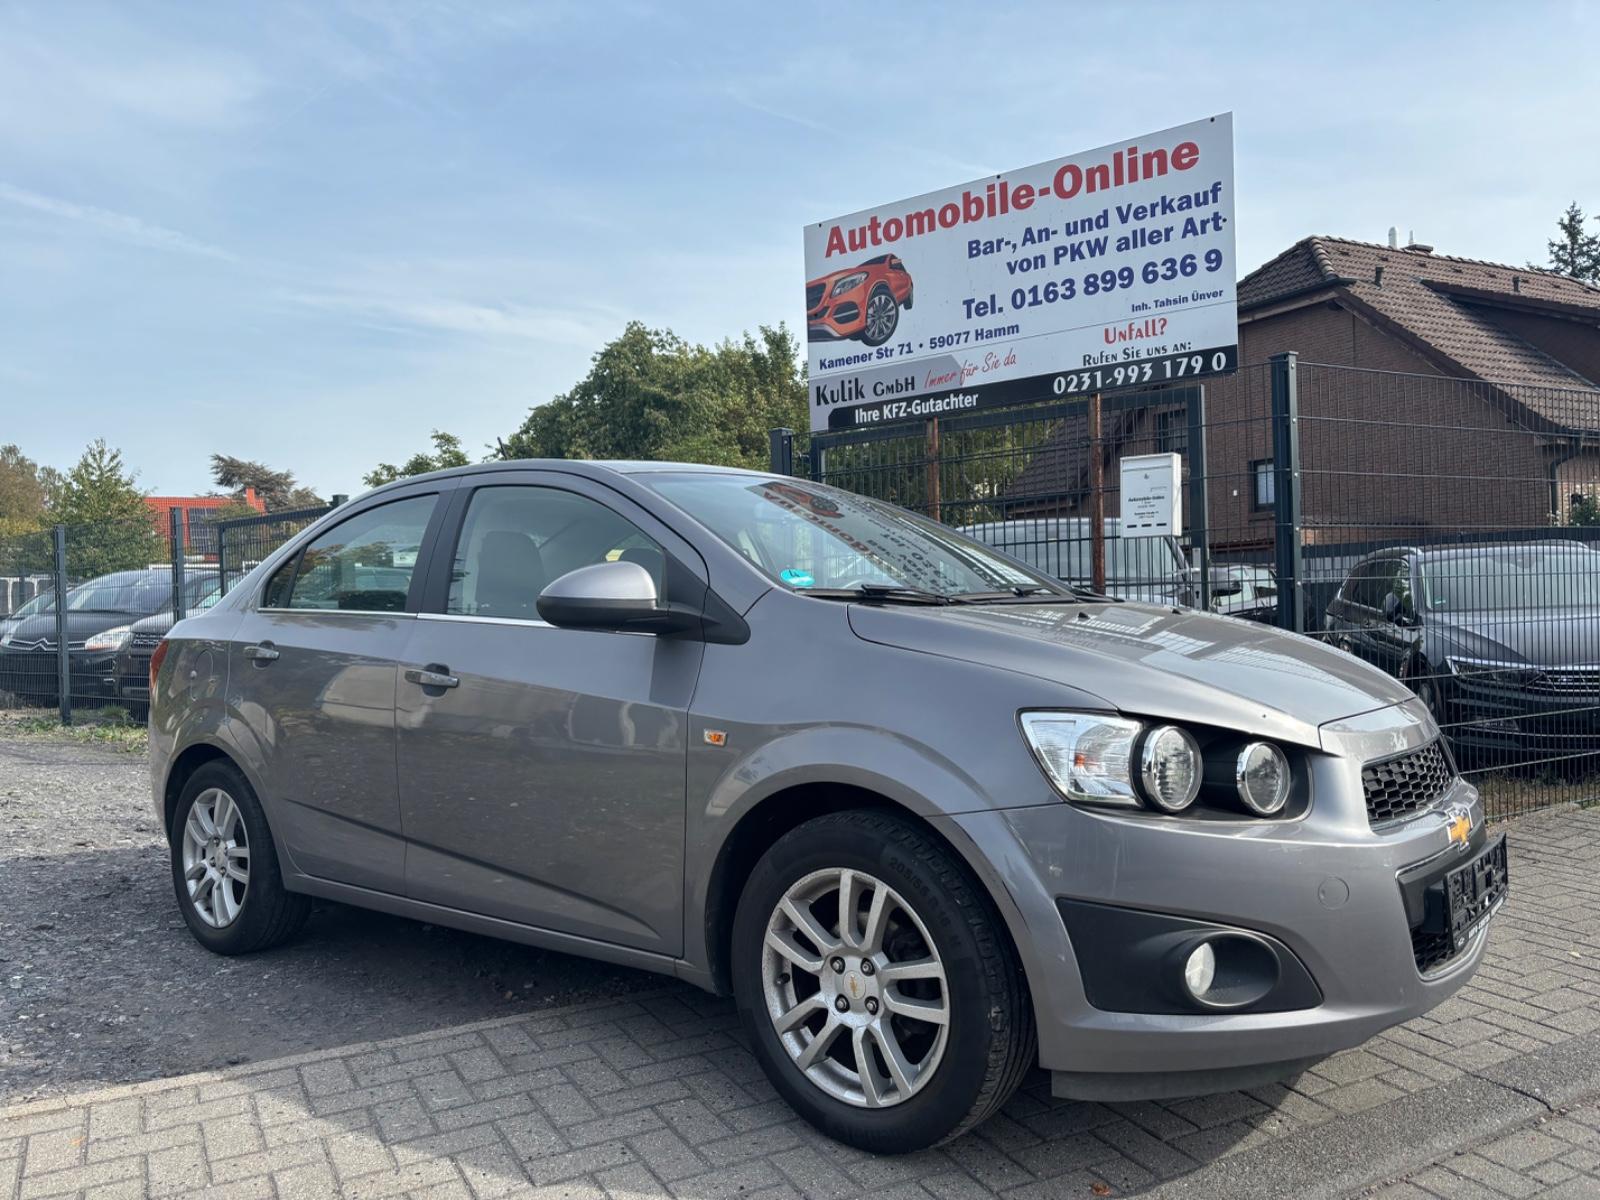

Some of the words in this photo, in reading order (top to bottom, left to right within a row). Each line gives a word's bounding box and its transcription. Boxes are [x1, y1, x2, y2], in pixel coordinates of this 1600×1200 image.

[825, 142, 1199, 258] Automobile-Online
[968, 237, 1017, 259] Bar-,
[1022, 227, 1058, 247] An-
[1065, 208, 1109, 237] und
[1115, 181, 1222, 224] Verkauf
[1006, 254, 1046, 275] von
[1054, 235, 1109, 265] PKW
[1116, 226, 1174, 253] aller
[962, 294, 1004, 320] Tel.
[1011, 278, 1077, 310] 0163
[1083, 266, 1135, 296] 899
[1142, 253, 1198, 284] 636
[1204, 248, 1223, 273] 9
[1131, 302, 1152, 313] Inh.
[1153, 295, 1189, 309] Tahsin
[1191, 289, 1224, 302] Ünver
[820, 352, 873, 370] Kamener
[876, 346, 895, 360] Str
[897, 342, 914, 356] 71
[929, 330, 971, 349] 59077
[975, 324, 1020, 341] Hamm
[924, 368, 958, 390] Immer
[959, 359, 979, 387] für
[982, 351, 1001, 372] Sie
[1004, 347, 1017, 367] da
[816, 377, 866, 406] Kulik
[873, 376, 915, 397] GmbH
[1052, 362, 1153, 395] 0231-993
[1162, 355, 1204, 379] 179
[1211, 352, 1227, 372] 0
[855, 408, 880, 424] Ihre
[883, 393, 979, 420] KFZ-Gutachter
